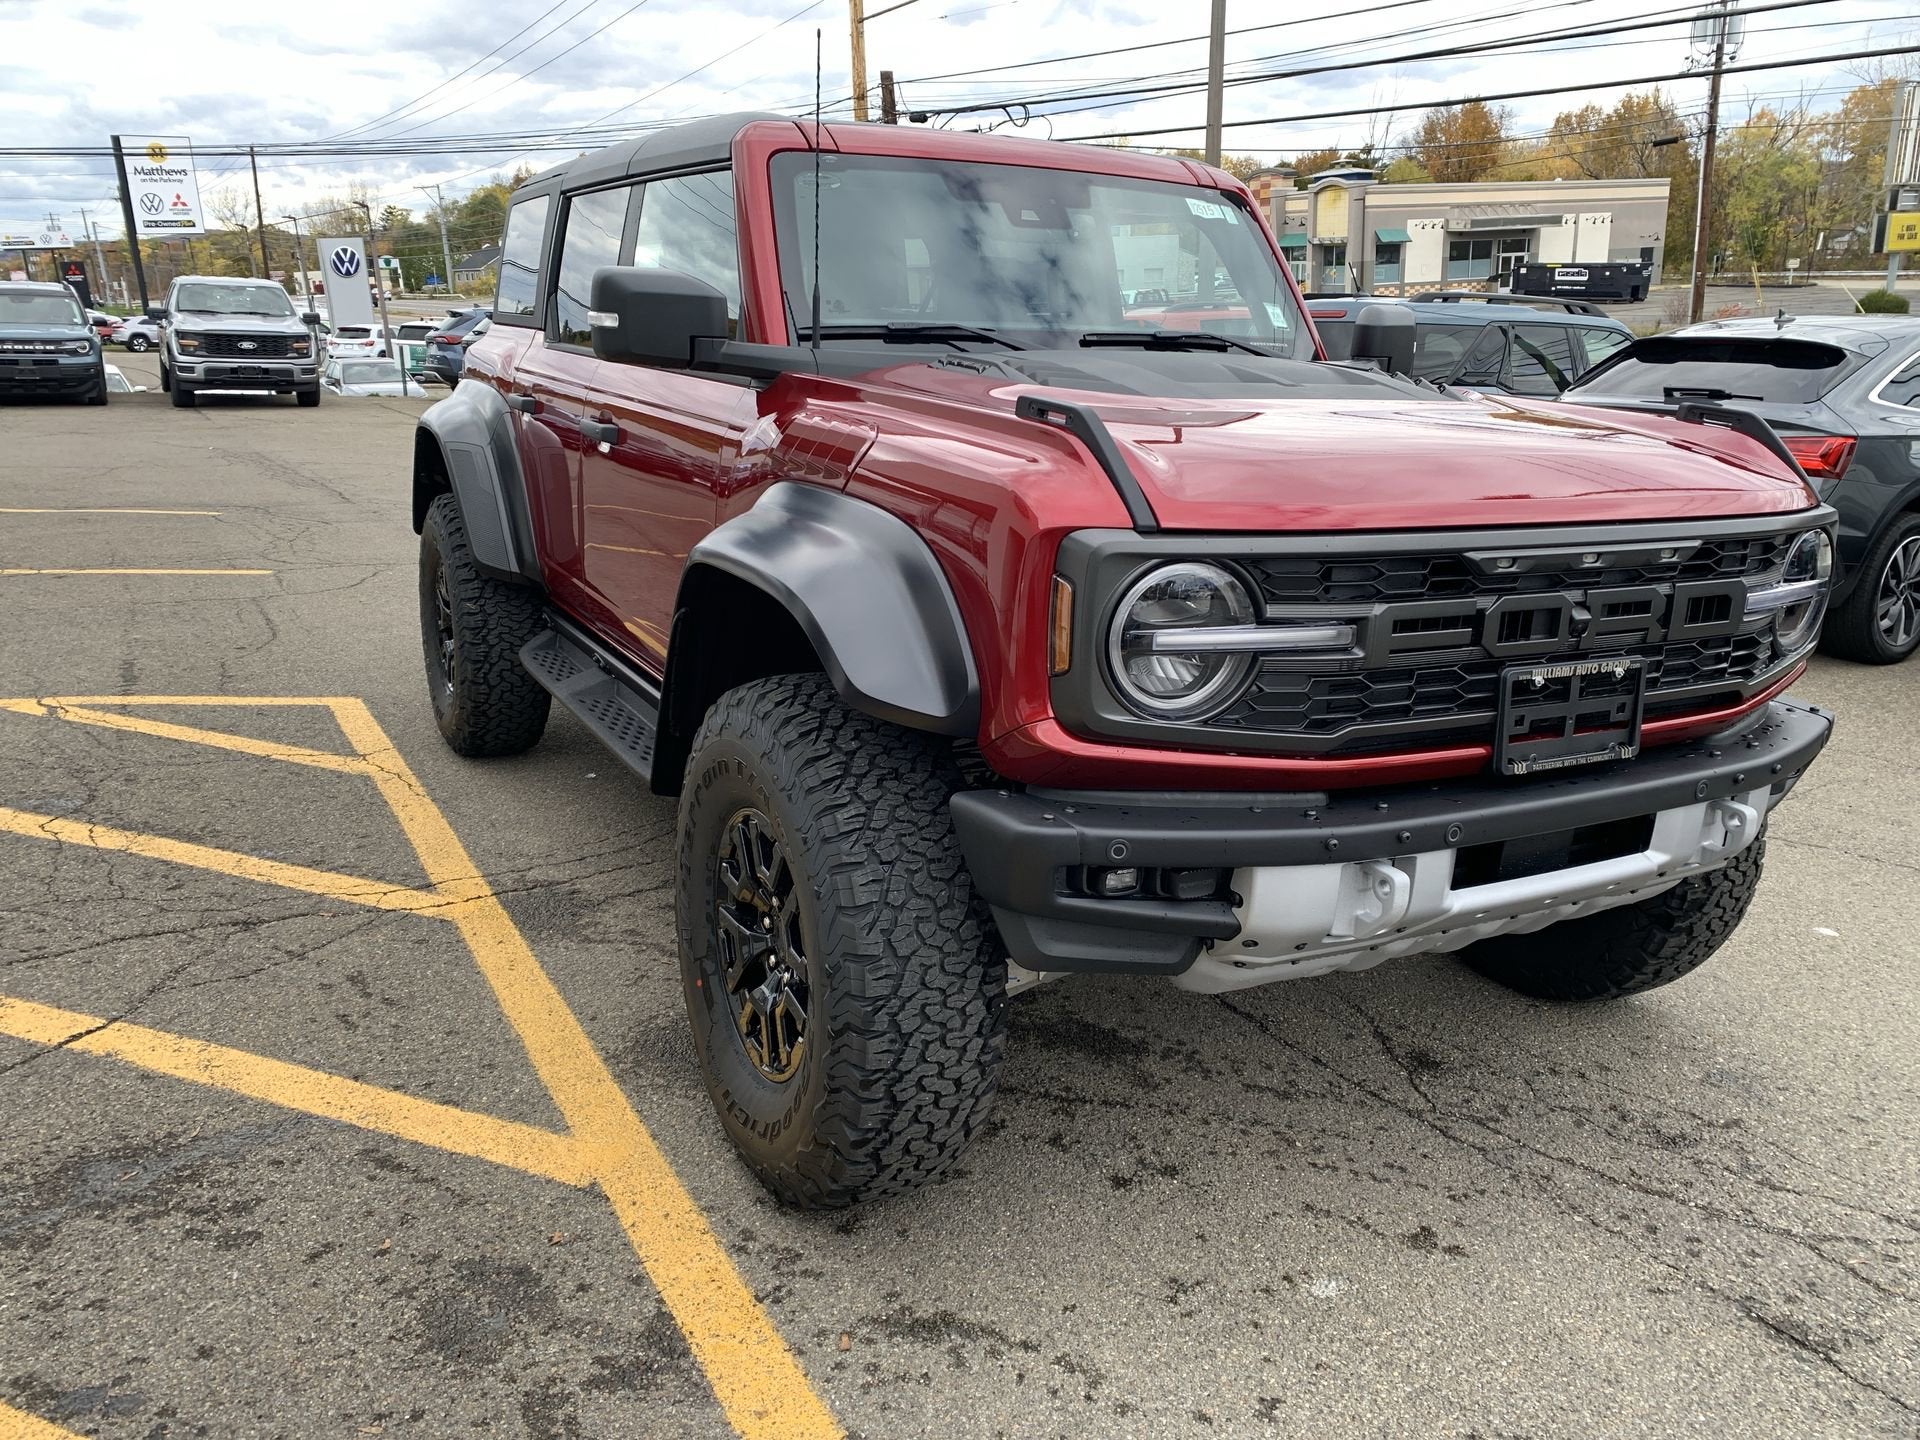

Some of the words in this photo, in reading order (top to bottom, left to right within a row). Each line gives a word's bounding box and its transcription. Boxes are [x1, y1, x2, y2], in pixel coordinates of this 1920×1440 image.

[133, 165, 188, 176] Matthews
[1367, 577, 1748, 668] FORD
[1575, 664, 1599, 676] AUTO
[1532, 760, 1563, 771] PARTNERING
[1564, 758, 1577, 767] WITH
[1577, 757, 1587, 765] THE
[1587, 753, 1615, 763] COMMUNITY
